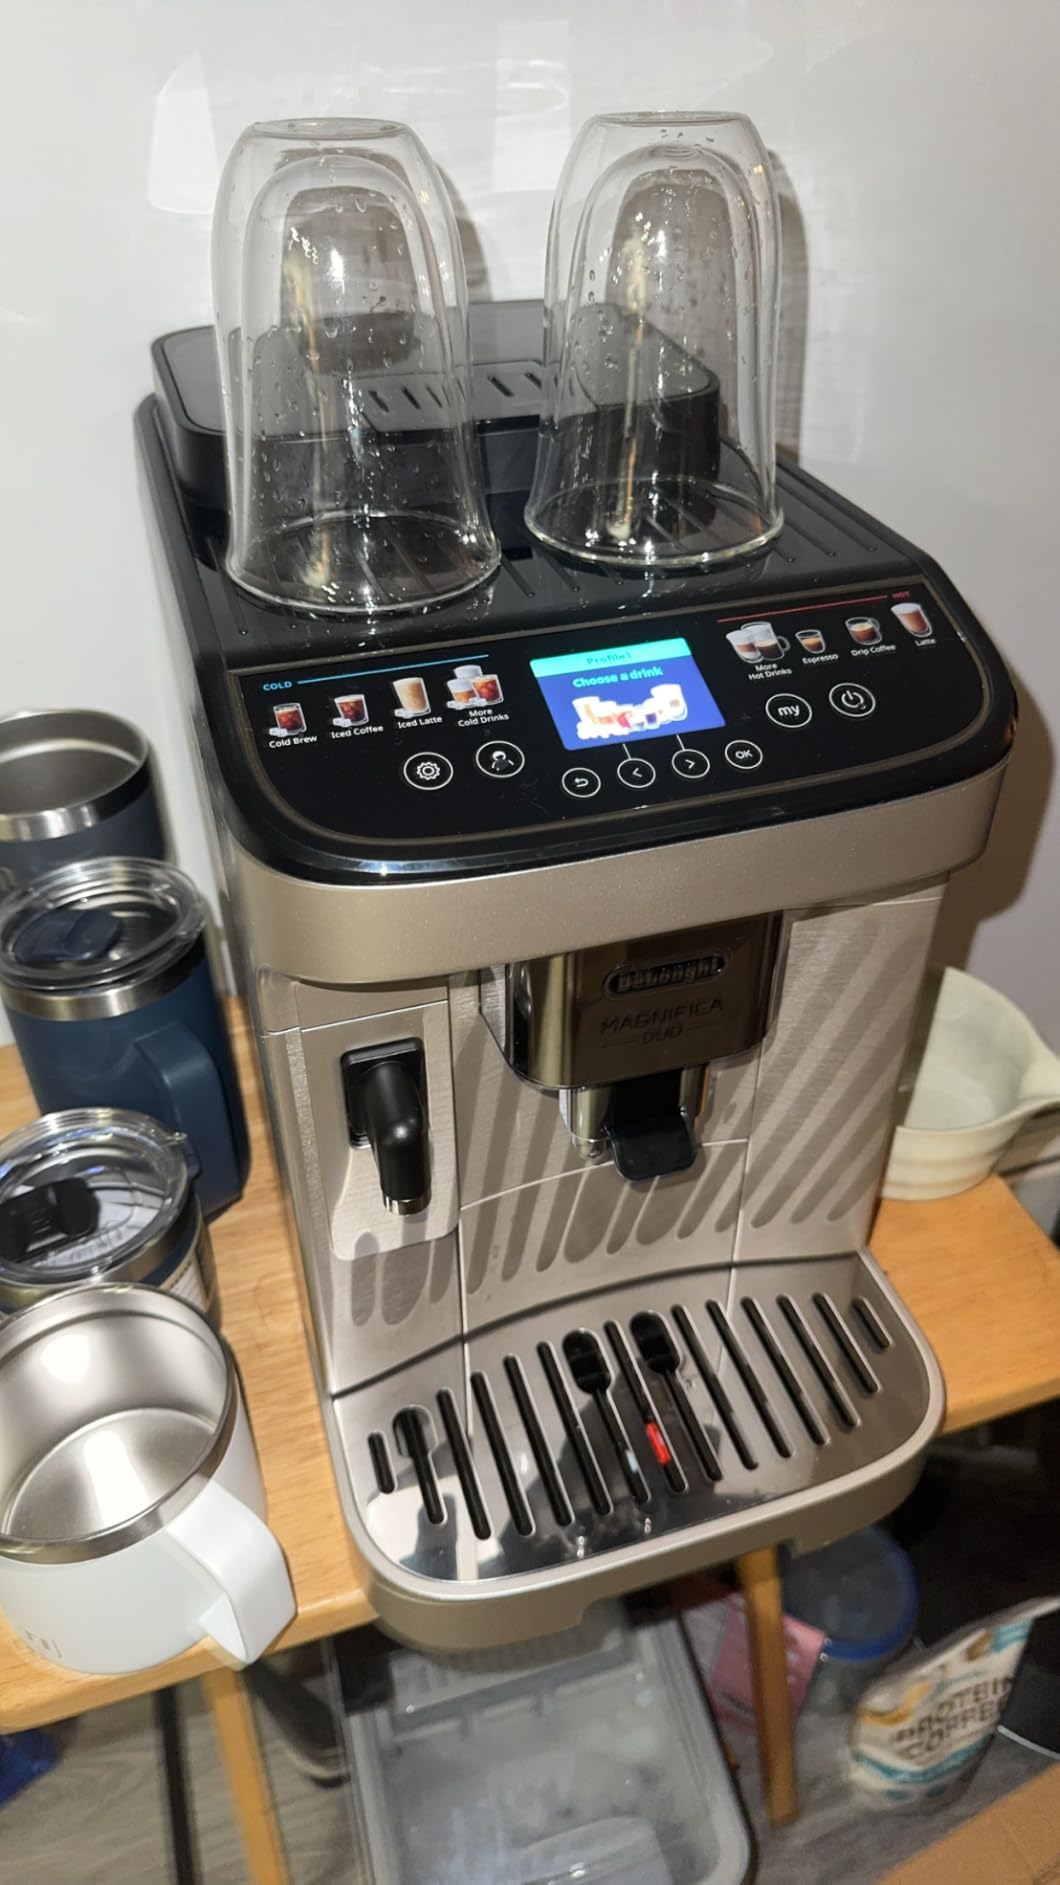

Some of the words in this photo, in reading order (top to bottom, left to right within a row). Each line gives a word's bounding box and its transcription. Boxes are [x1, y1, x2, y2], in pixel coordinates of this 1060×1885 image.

[891, 591, 911, 600] HOT
[914, 639, 937, 647] Latte
[850, 649, 870, 657] Drip
[869, 644, 897, 654] Coffee
[802, 653, 839, 664] Espresso
[748, 671, 764, 680] Hot
[764, 668, 793, 678] Drinks
[755, 663, 778, 672] More
[572, 675, 618, 688] Choose
[620, 673, 630, 681] a
[629, 665, 664, 680] drink
[262, 681, 293, 691] COLD
[468, 708, 493, 717] More
[777, 704, 801, 717] my
[397, 721, 418, 729] Iced
[419, 716, 443, 726] Latte
[457, 719, 479, 727] Cold
[479, 713, 510, 723] Drinks
[331, 729, 352, 739] Iced
[353, 725, 384, 735] Coffee
[268, 739, 291, 749] Cold
[292, 735, 318, 745] Brew
[735, 749, 753, 759] OK
[600, 999, 722, 1035] MAGNIFICA
[642, 1025, 683, 1044] DUO
